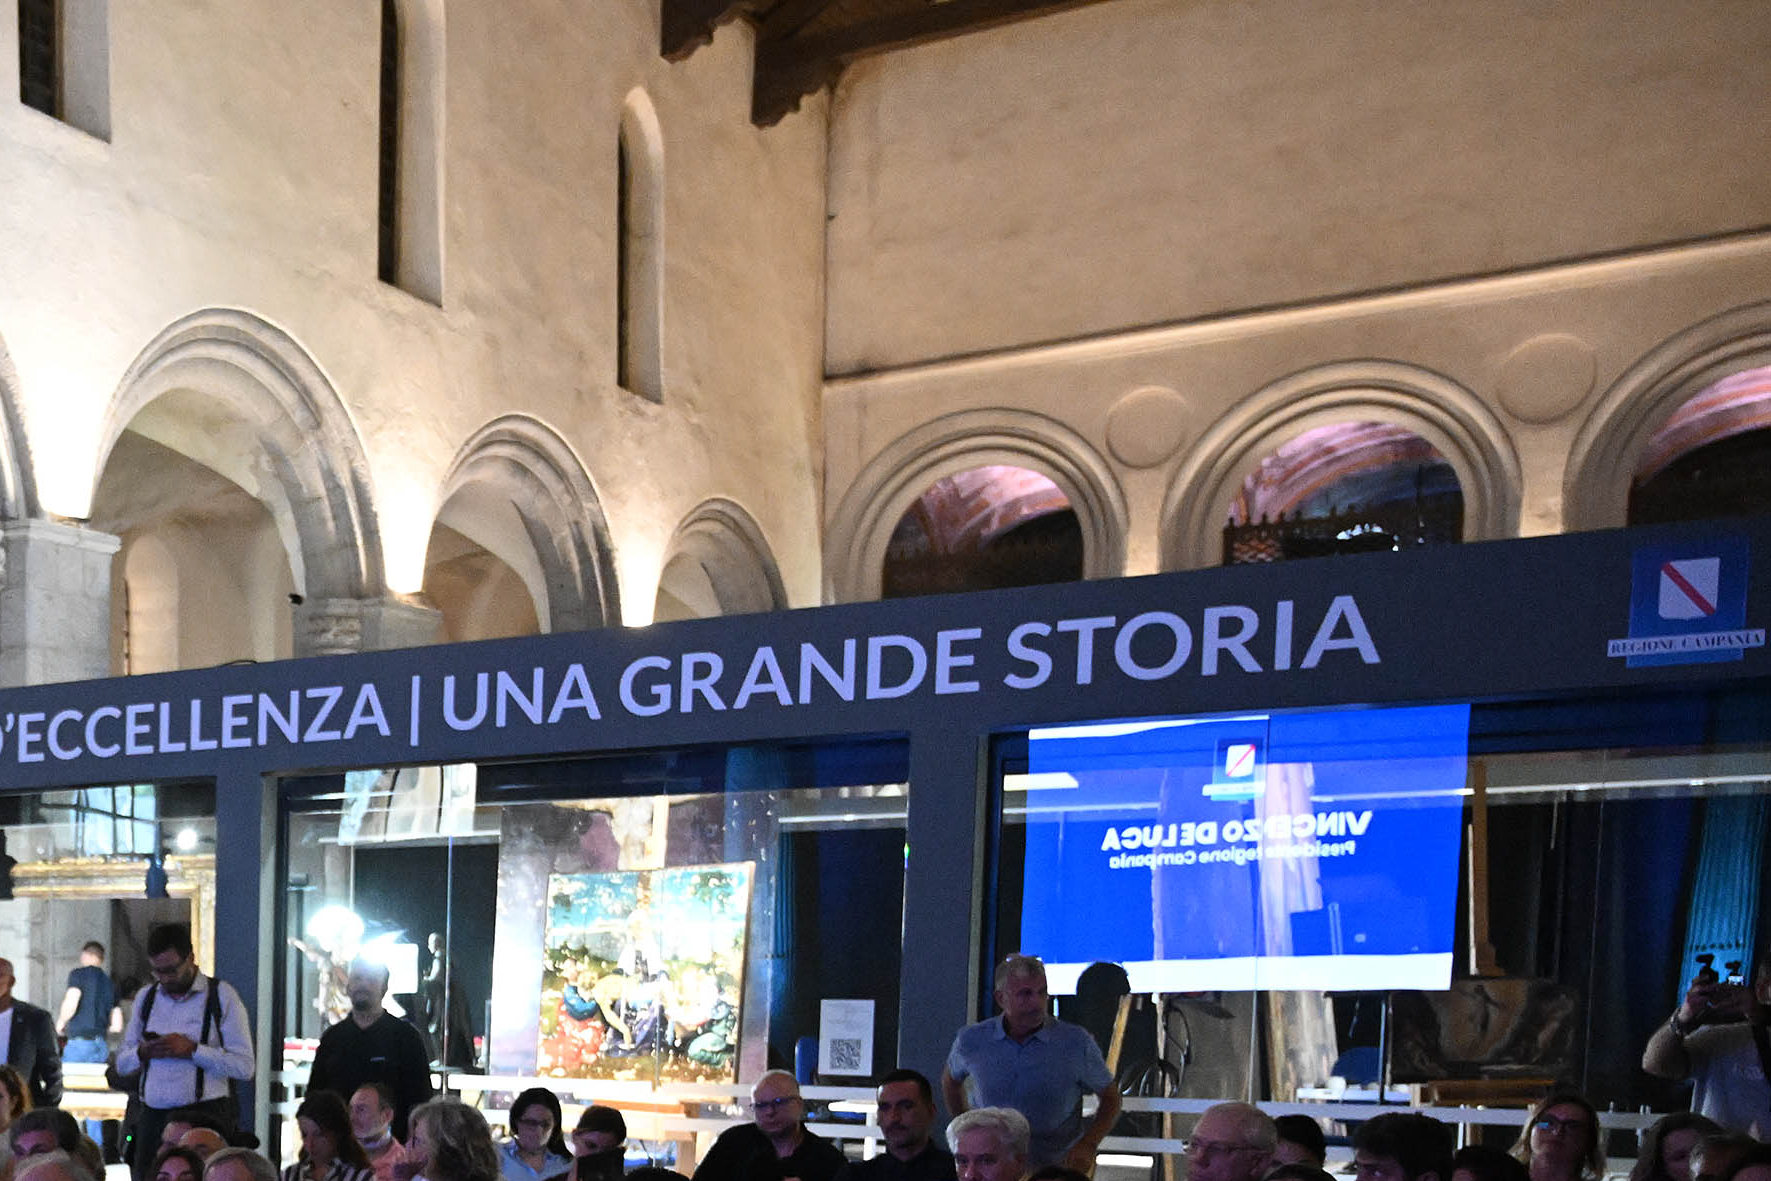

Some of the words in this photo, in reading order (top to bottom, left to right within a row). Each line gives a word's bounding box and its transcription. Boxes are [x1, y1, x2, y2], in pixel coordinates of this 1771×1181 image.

[442, 663, 602, 732] UNA
[618, 627, 983, 717] GRANDE
[1002, 595, 1382, 690] STORIA
[1611, 639, 1675, 653] REGIONE
[1681, 633, 1761, 648] CAMPANIA
